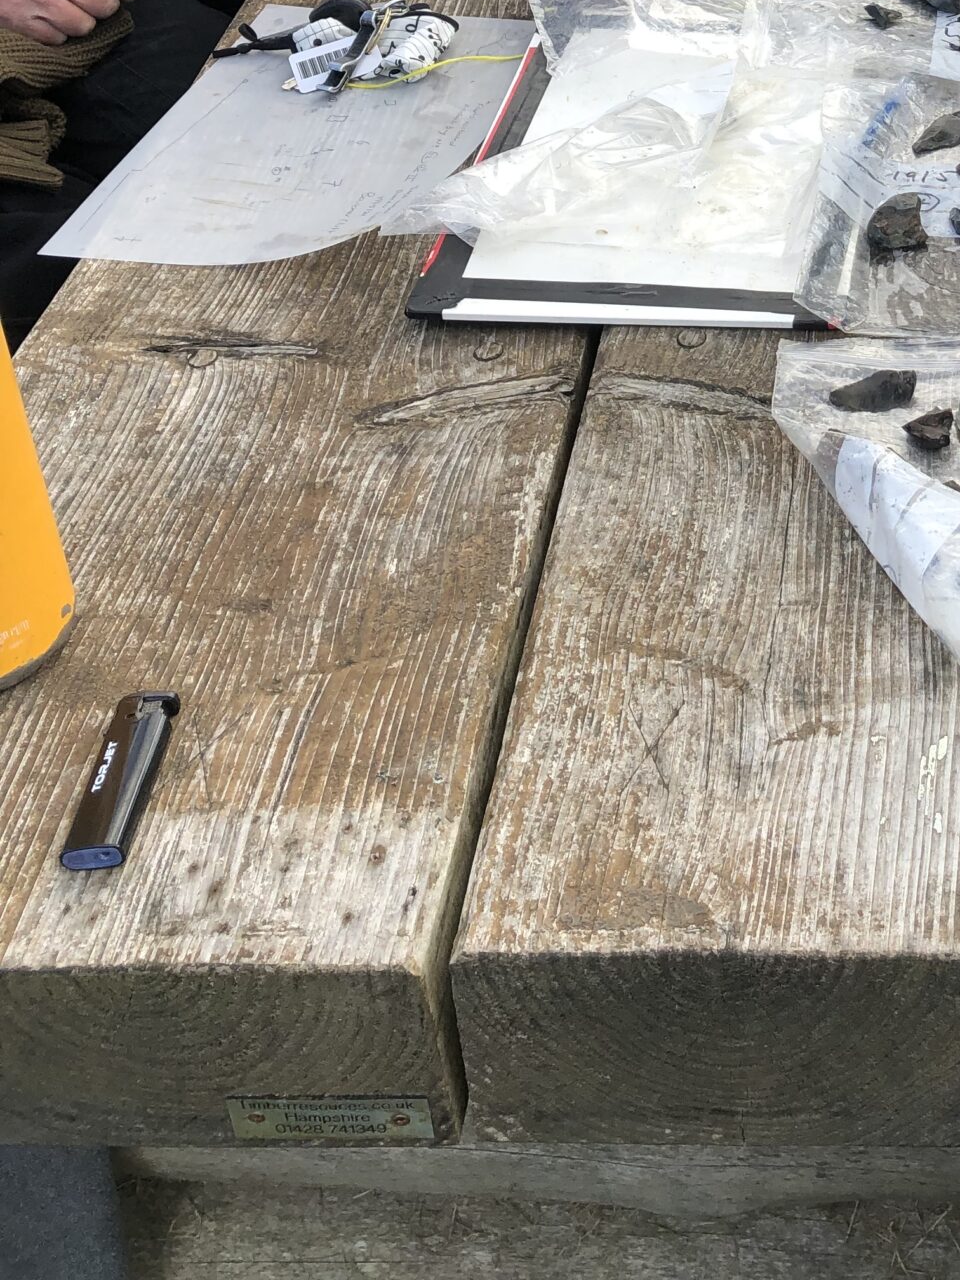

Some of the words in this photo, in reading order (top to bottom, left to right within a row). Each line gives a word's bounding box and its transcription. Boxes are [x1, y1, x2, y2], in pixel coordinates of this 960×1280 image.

[90, 740, 119, 793] TORJET
[285, 1112, 371, 1123] Hampshire
[275, 1123, 324, 1134] 01428
[330, 1123, 387, 1134] 741349
